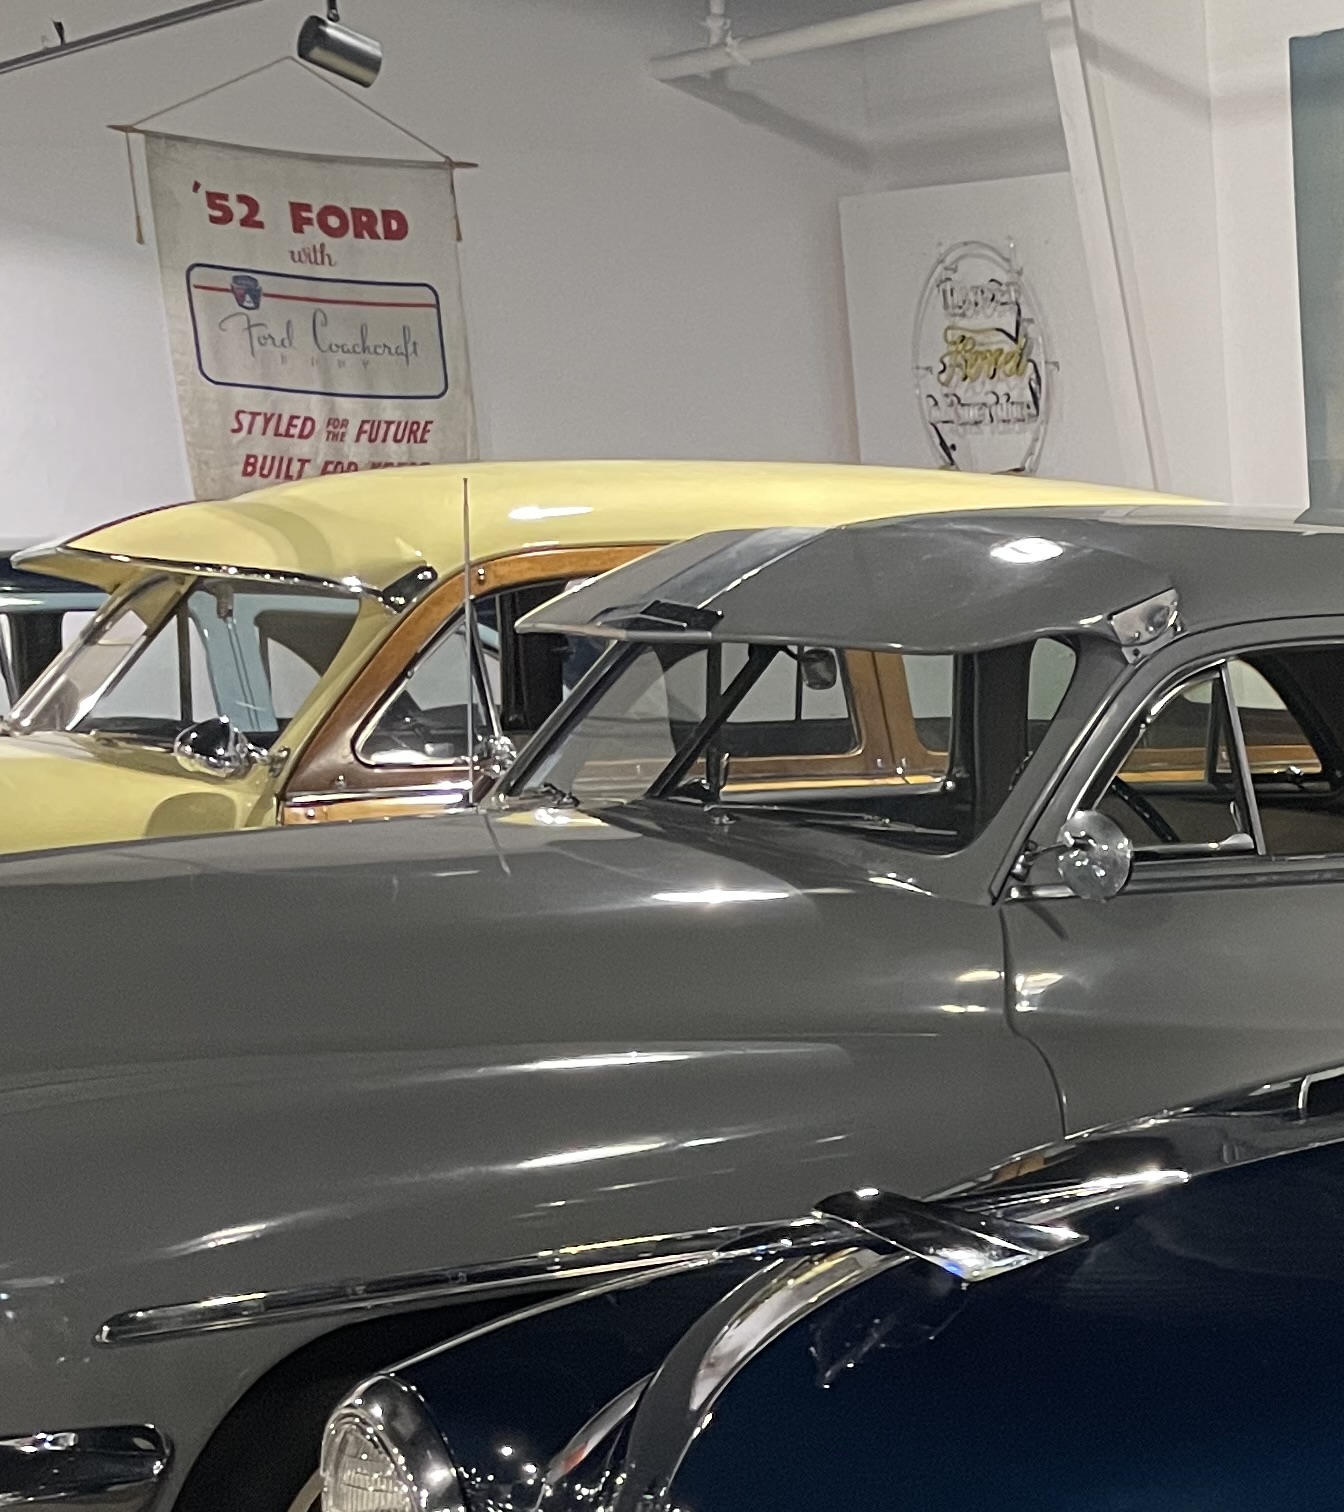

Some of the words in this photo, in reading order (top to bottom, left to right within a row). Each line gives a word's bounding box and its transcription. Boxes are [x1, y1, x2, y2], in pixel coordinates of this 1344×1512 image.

[192, 180, 265, 230] '52
[288, 201, 409, 241] FORD
[289, 242, 336, 267] with
[219, 311, 294, 357] Ford
[312, 307, 419, 366] Coachcraft
[230, 409, 316, 440] STYLED
[325, 430, 347, 442] THE
[326, 417, 349, 429] FOR
[354, 419, 434, 444] FUTURE
[241, 454, 312, 481] BUILT
